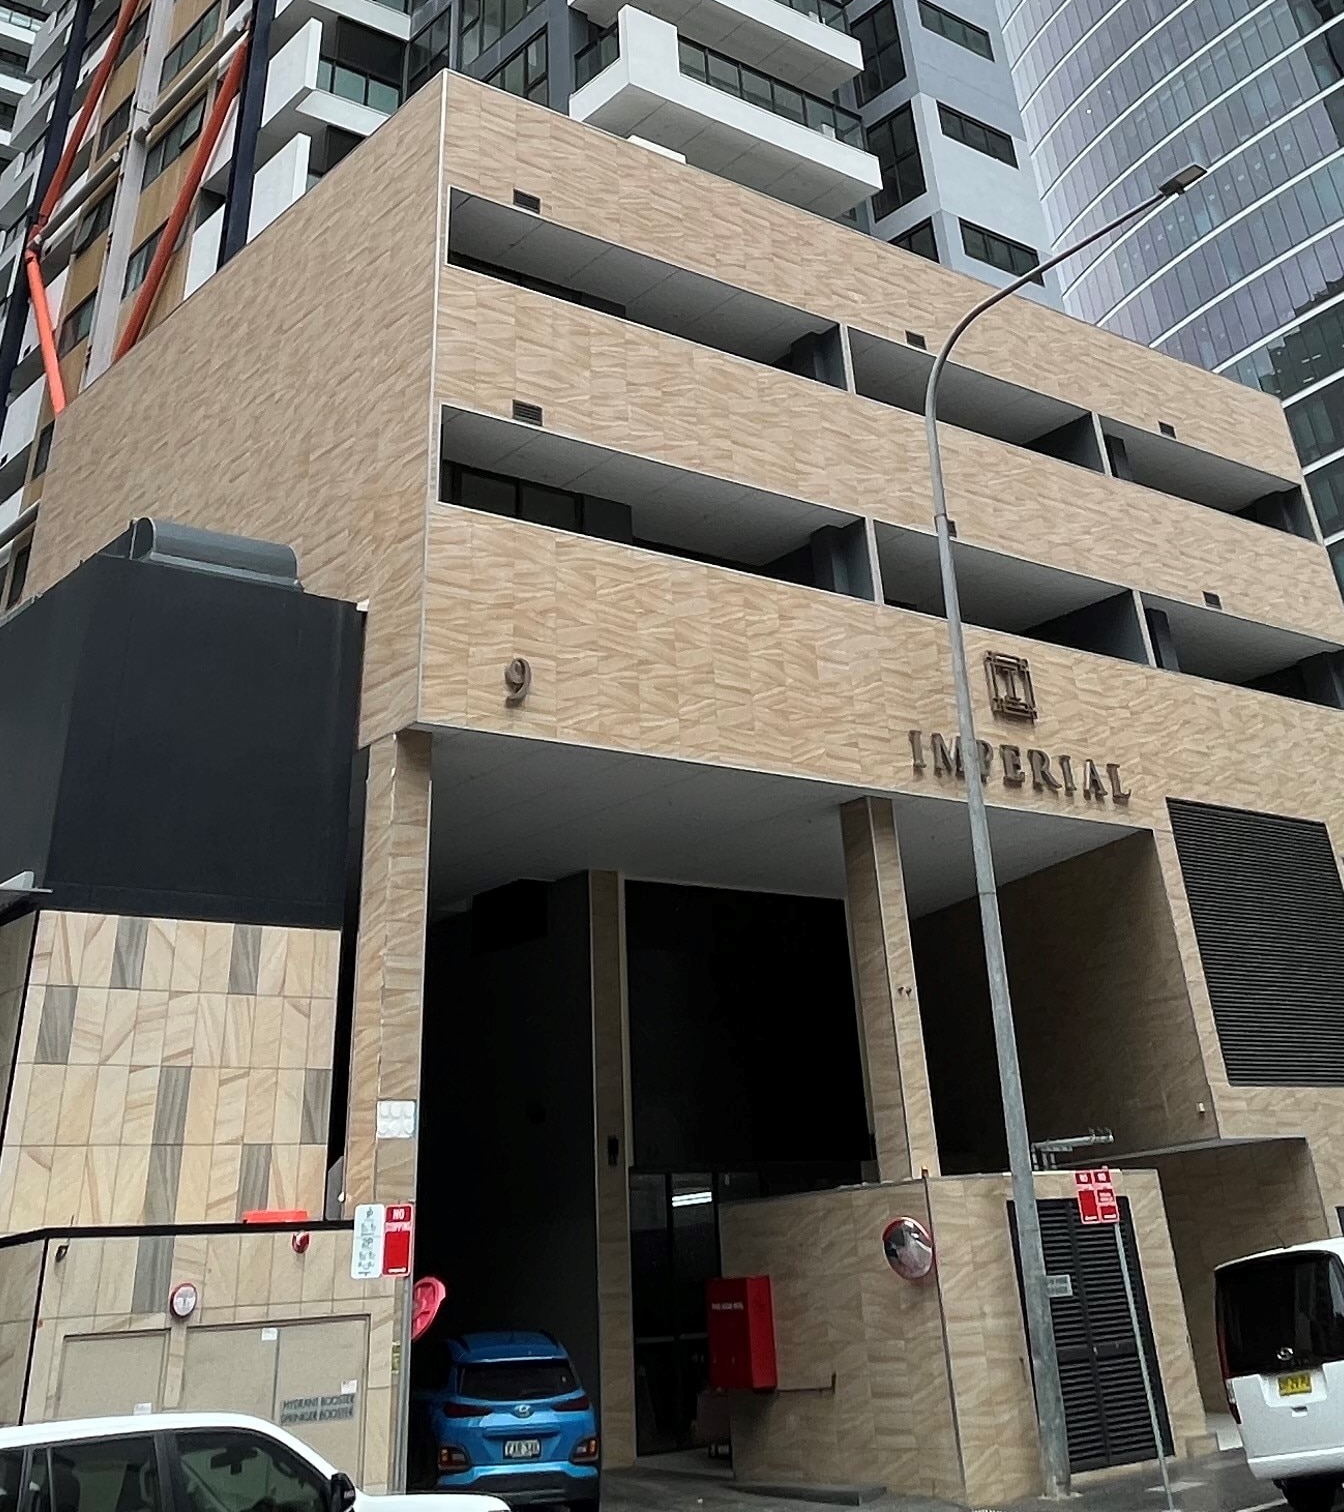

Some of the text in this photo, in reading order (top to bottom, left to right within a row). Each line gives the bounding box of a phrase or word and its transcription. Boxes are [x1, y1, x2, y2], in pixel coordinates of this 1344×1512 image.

[504, 657, 532, 709] 9
[908, 729, 1132, 804] IMPERIAL
[392, 1208, 406, 1220] NO
